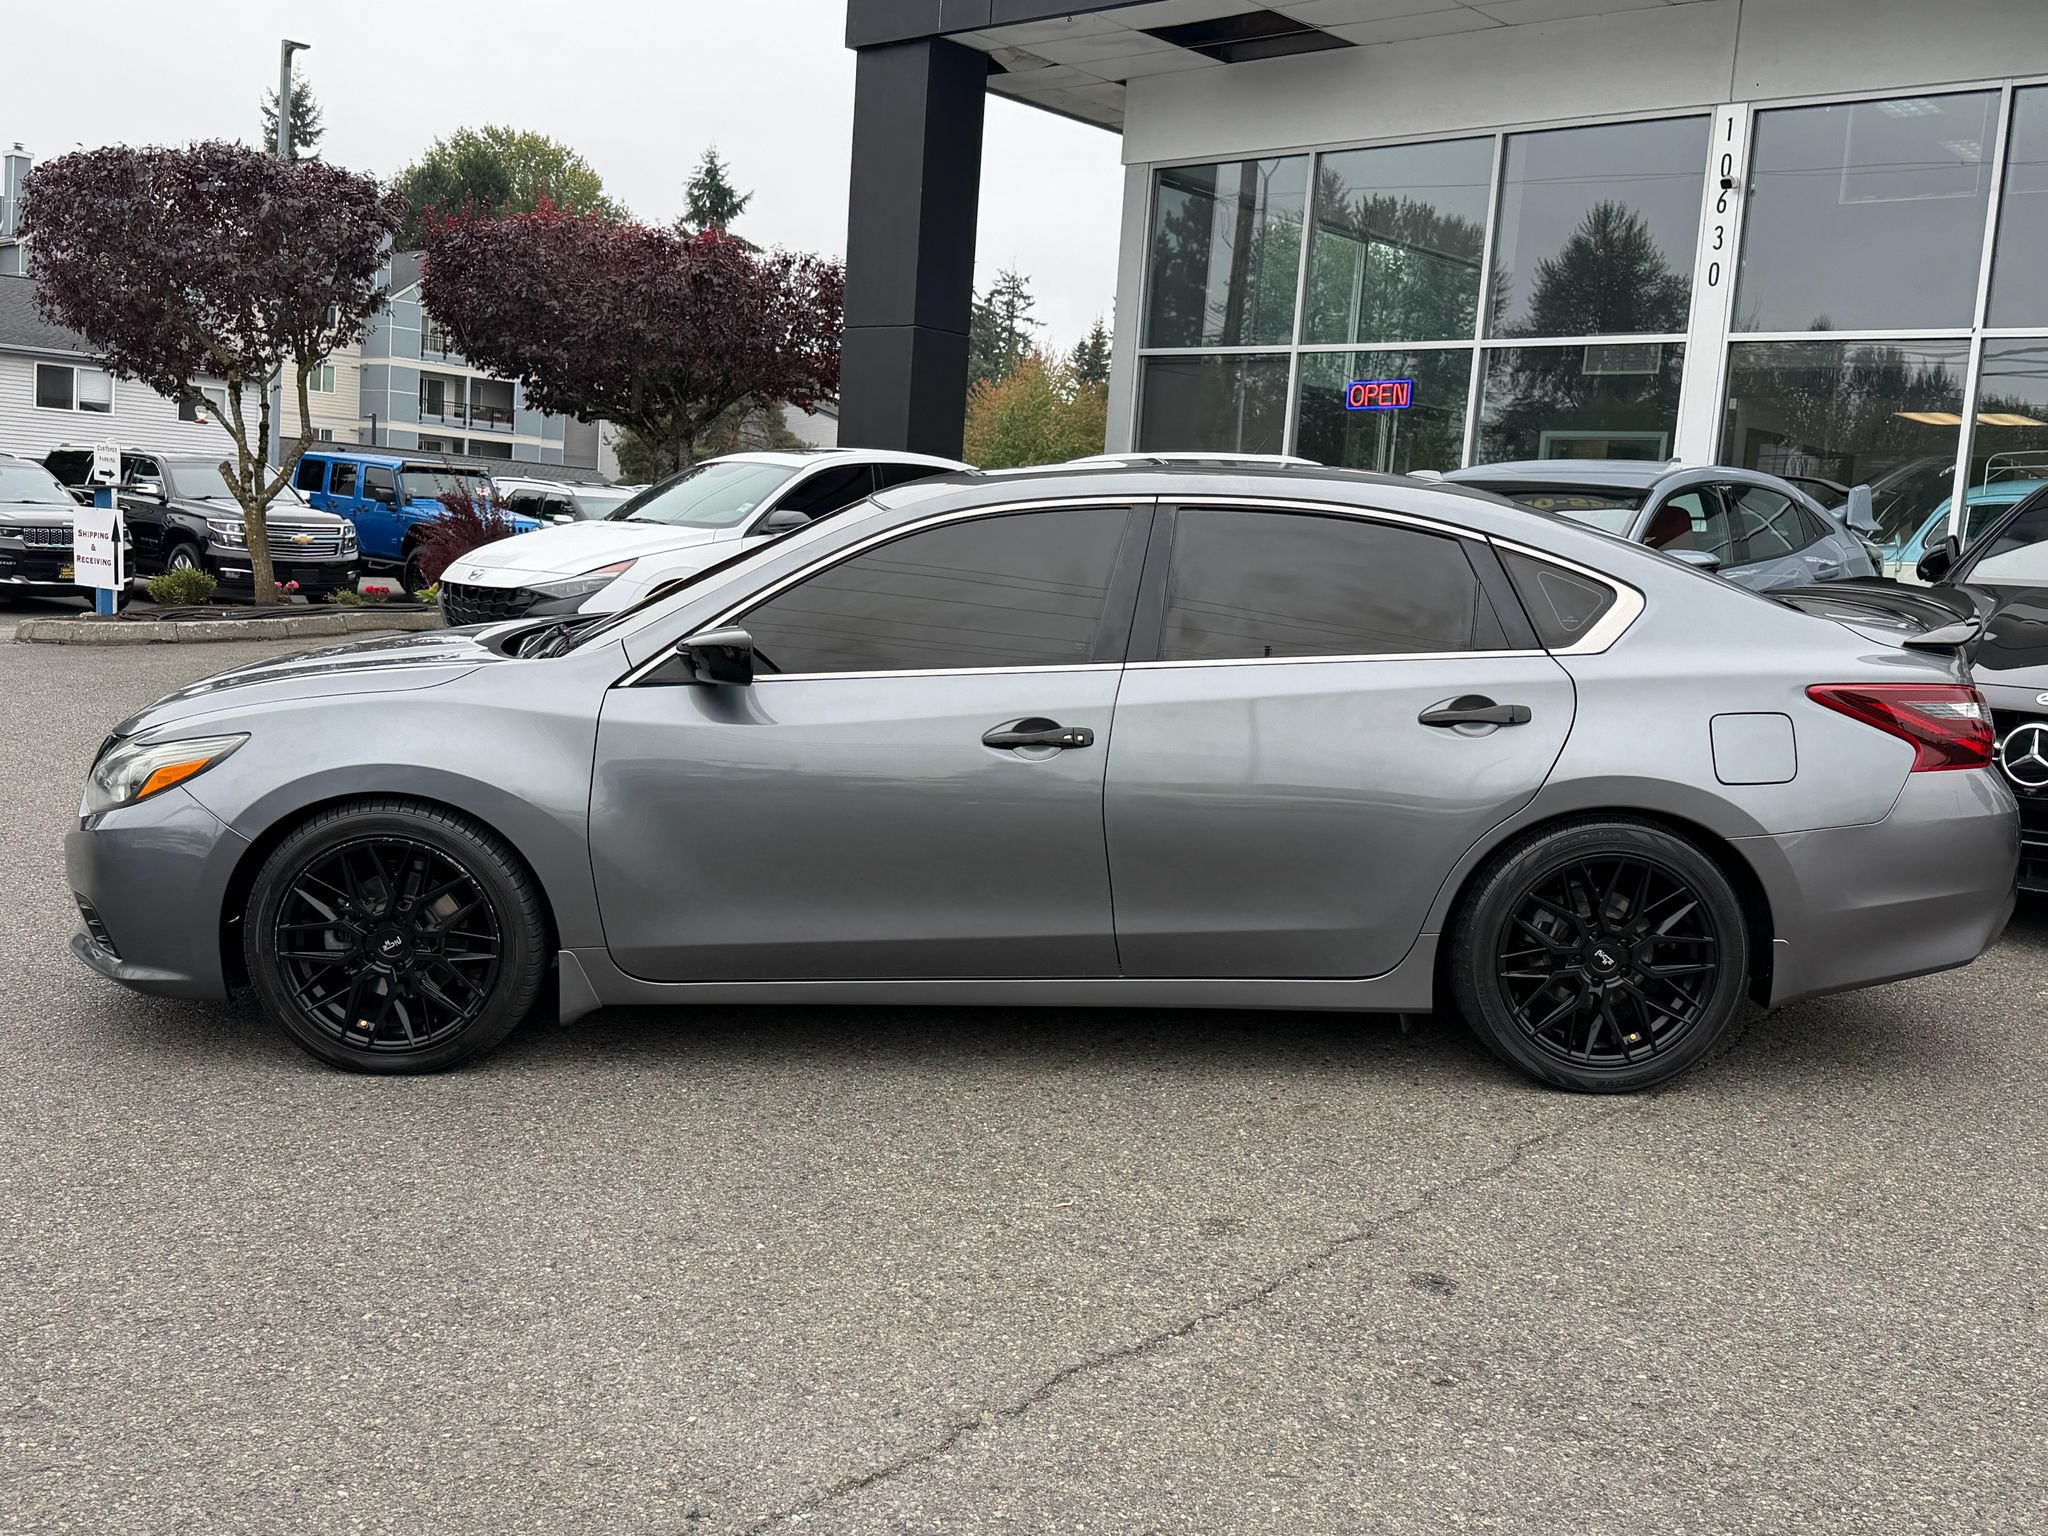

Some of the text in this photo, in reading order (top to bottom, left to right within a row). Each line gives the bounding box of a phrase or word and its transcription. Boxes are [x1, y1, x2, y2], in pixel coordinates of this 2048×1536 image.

[1708, 117, 1734, 287] 10630
[1350, 383, 1408, 407] OPEN
[77, 529, 109, 540] SHIPPING
[90, 544, 97, 552] &
[76, 554, 112, 567] RECEIVING
